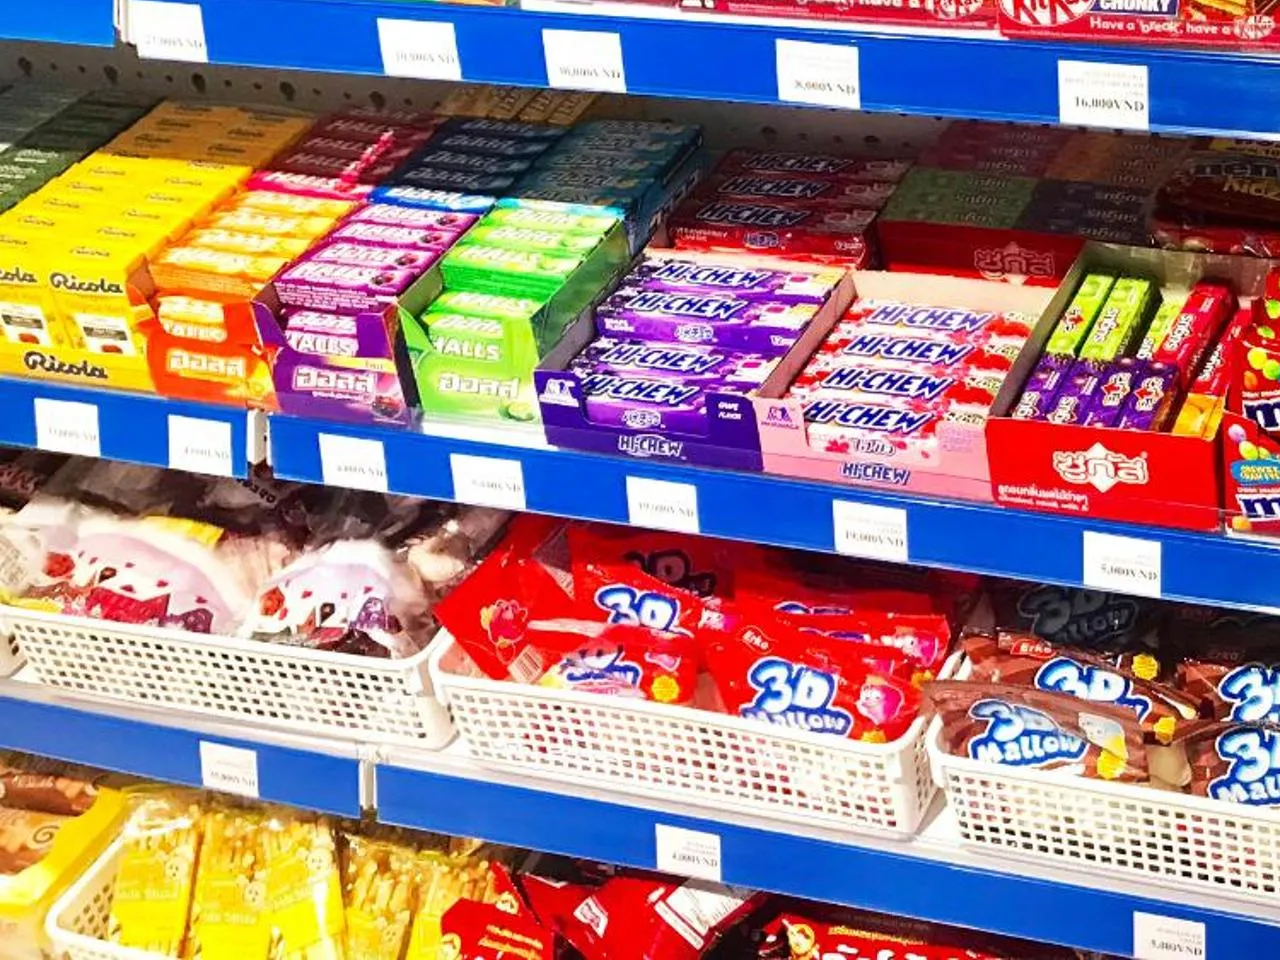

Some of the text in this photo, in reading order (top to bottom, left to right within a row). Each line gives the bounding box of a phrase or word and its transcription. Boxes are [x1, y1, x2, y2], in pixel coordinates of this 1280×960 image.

[908, 0, 924, 8] a
[1090, 17, 1123, 32] Have
[1126, 22, 1135, 32] a
[1186, 23, 1220, 37] have
[1223, 27, 1232, 36] a
[50, 273, 123, 294] Ricola
[653, 264, 771, 288] HI-CHEW
[625, 292, 748, 319] HI-CHEW
[867, 305, 994, 332] HI-CHEW
[601, 344, 724, 373] HI-CHEW
[844, 335, 974, 363] HI-CHEW
[24, 351, 108, 380] Ricola
[581, 375, 700, 405] HI-CHEW
[821, 368, 953, 400] HI-CHEW
[803, 401, 936, 433] HI-CHEW
[619, 435, 683, 456] HI-CHEW
[842, 463, 911, 484] HI-CHEW
[751, 658, 838, 713] 3D
[1037, 659, 1126, 700] 3D
[972, 732, 1086, 763] Mallow
